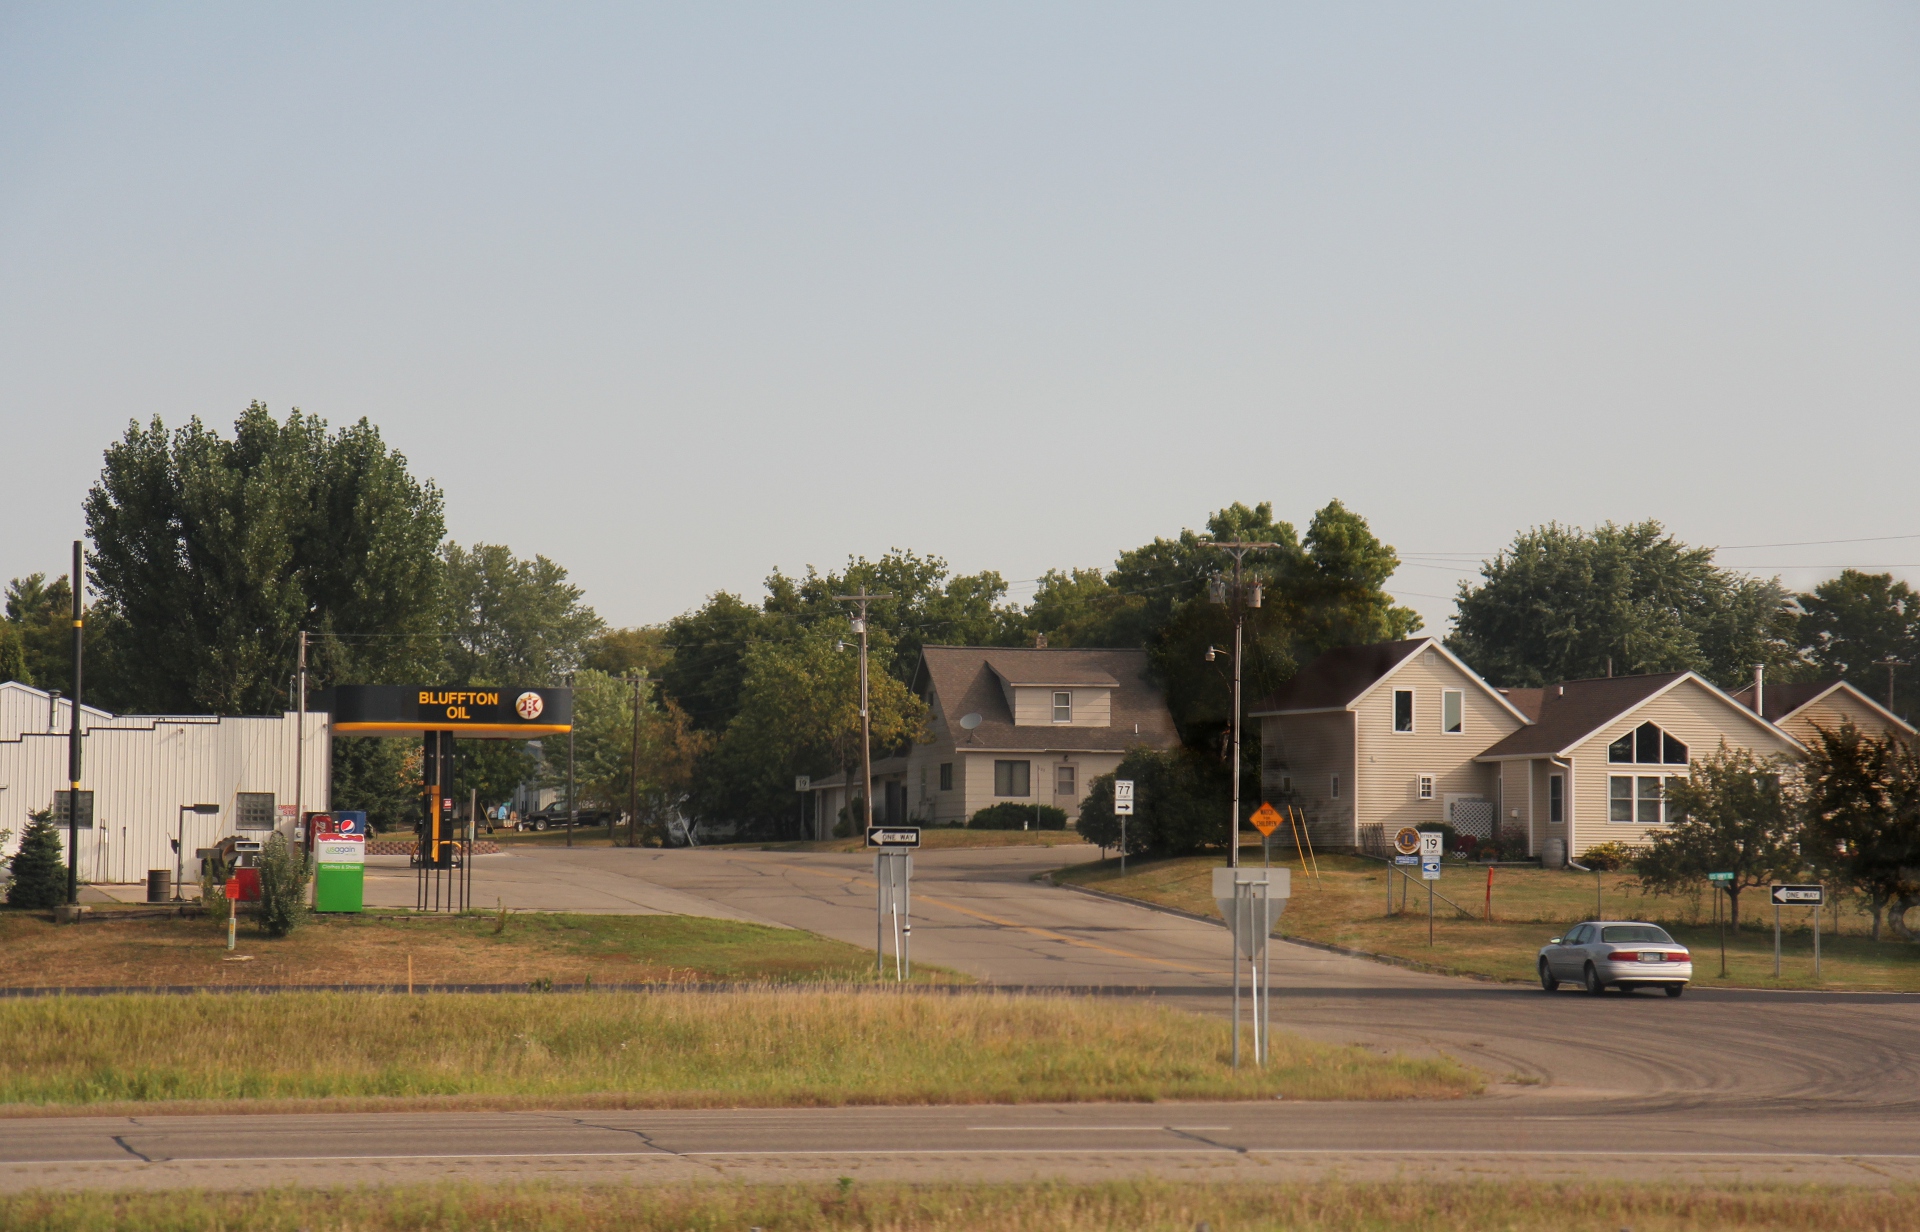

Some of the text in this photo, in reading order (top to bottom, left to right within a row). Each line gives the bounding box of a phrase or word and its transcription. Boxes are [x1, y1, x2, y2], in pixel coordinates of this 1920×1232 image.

[419, 691, 498, 705] BLUFFTON
[526, 699, 535, 711] B
[446, 706, 470, 718] OIL
[1118, 785, 1130, 795] 77
[1426, 839, 1437, 849] 19
[1786, 891, 1800, 899] ONE
